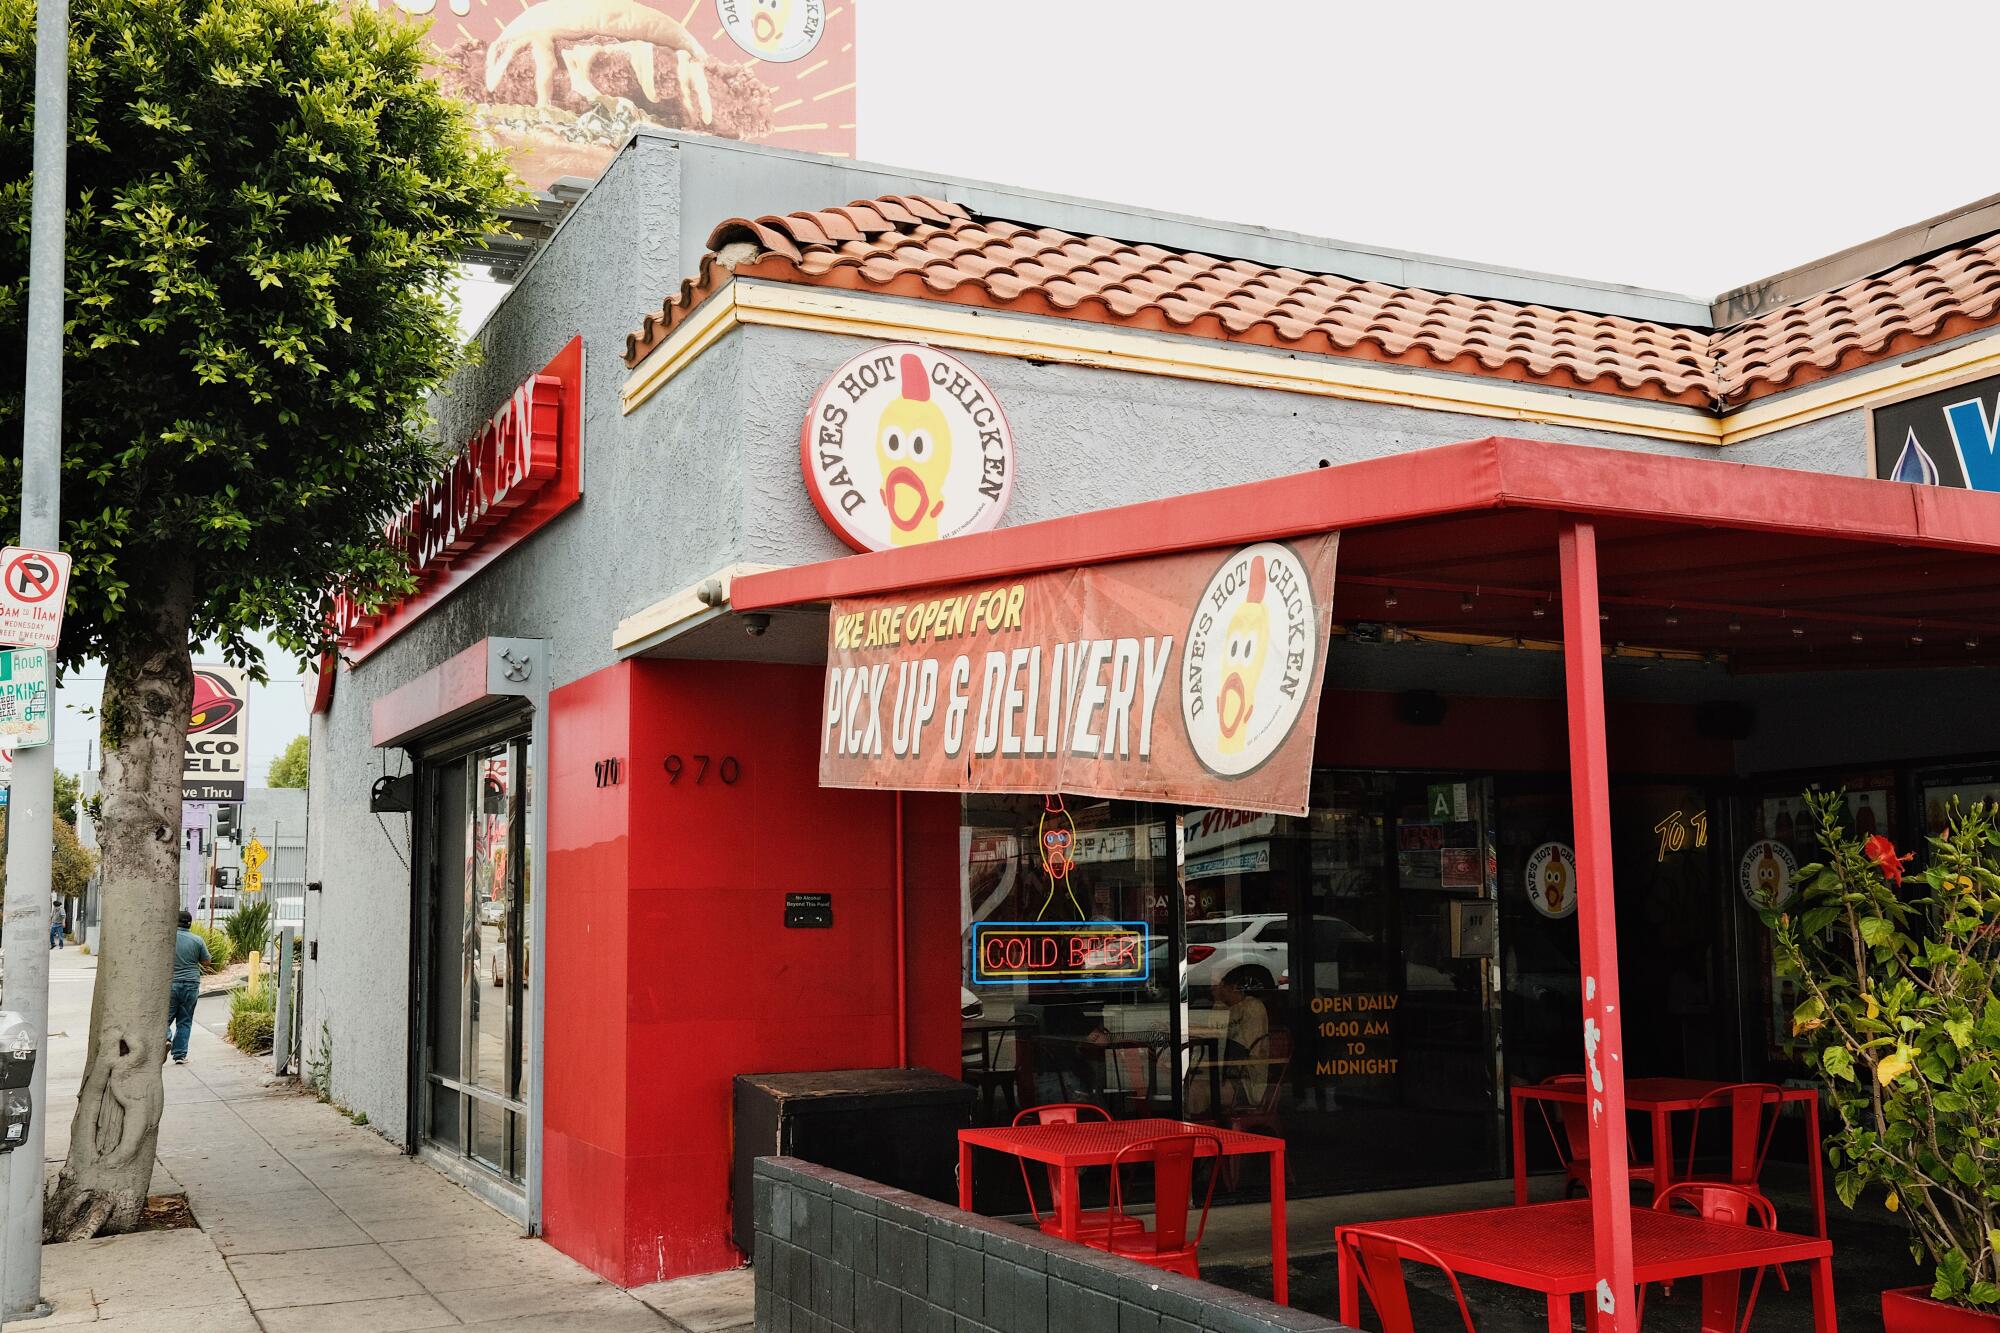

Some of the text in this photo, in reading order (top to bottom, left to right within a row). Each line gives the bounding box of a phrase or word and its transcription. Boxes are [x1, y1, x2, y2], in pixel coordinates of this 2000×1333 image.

[838, 355, 896, 403] HOT
[931, 362, 1006, 503] CHICKEN
[4, 620, 45, 631] WEDNESDAY
[834, 584, 1026, 650] WE ARE OPEN FOR
[19, 631, 56, 641] SWEEPING
[1189, 558, 1306, 722] DAVE'S HOT CHICKEN
[14, 656, 43, 671] HOUR
[0, 681, 44, 701] ARKING
[824, 662, 890, 757] PICK
[892, 658, 940, 757] UP
[943, 654, 971, 757] &
[974, 635, 1174, 760] DELIVERY
[184, 741, 239, 755] ACO
[184, 759, 240, 772] ELL
[594, 756, 618, 788] 970
[663, 754, 741, 785] 970
[202, 786, 233, 798] Thru
[1434, 793, 1449, 815] A
[1654, 811, 1686, 862] TO
[1534, 846, 1552, 863] HOT
[1746, 844, 1764, 862] HOT
[247, 873, 258, 884] 15
[986, 935, 1138, 969] COLD BEER
[1311, 994, 1399, 1013] OPEN DAILY
[1318, 1020, 1389, 1037] 10:00 AM
[1347, 1042, 1365, 1055] TO
[1316, 1058, 1398, 1075] MIDNIGHT
